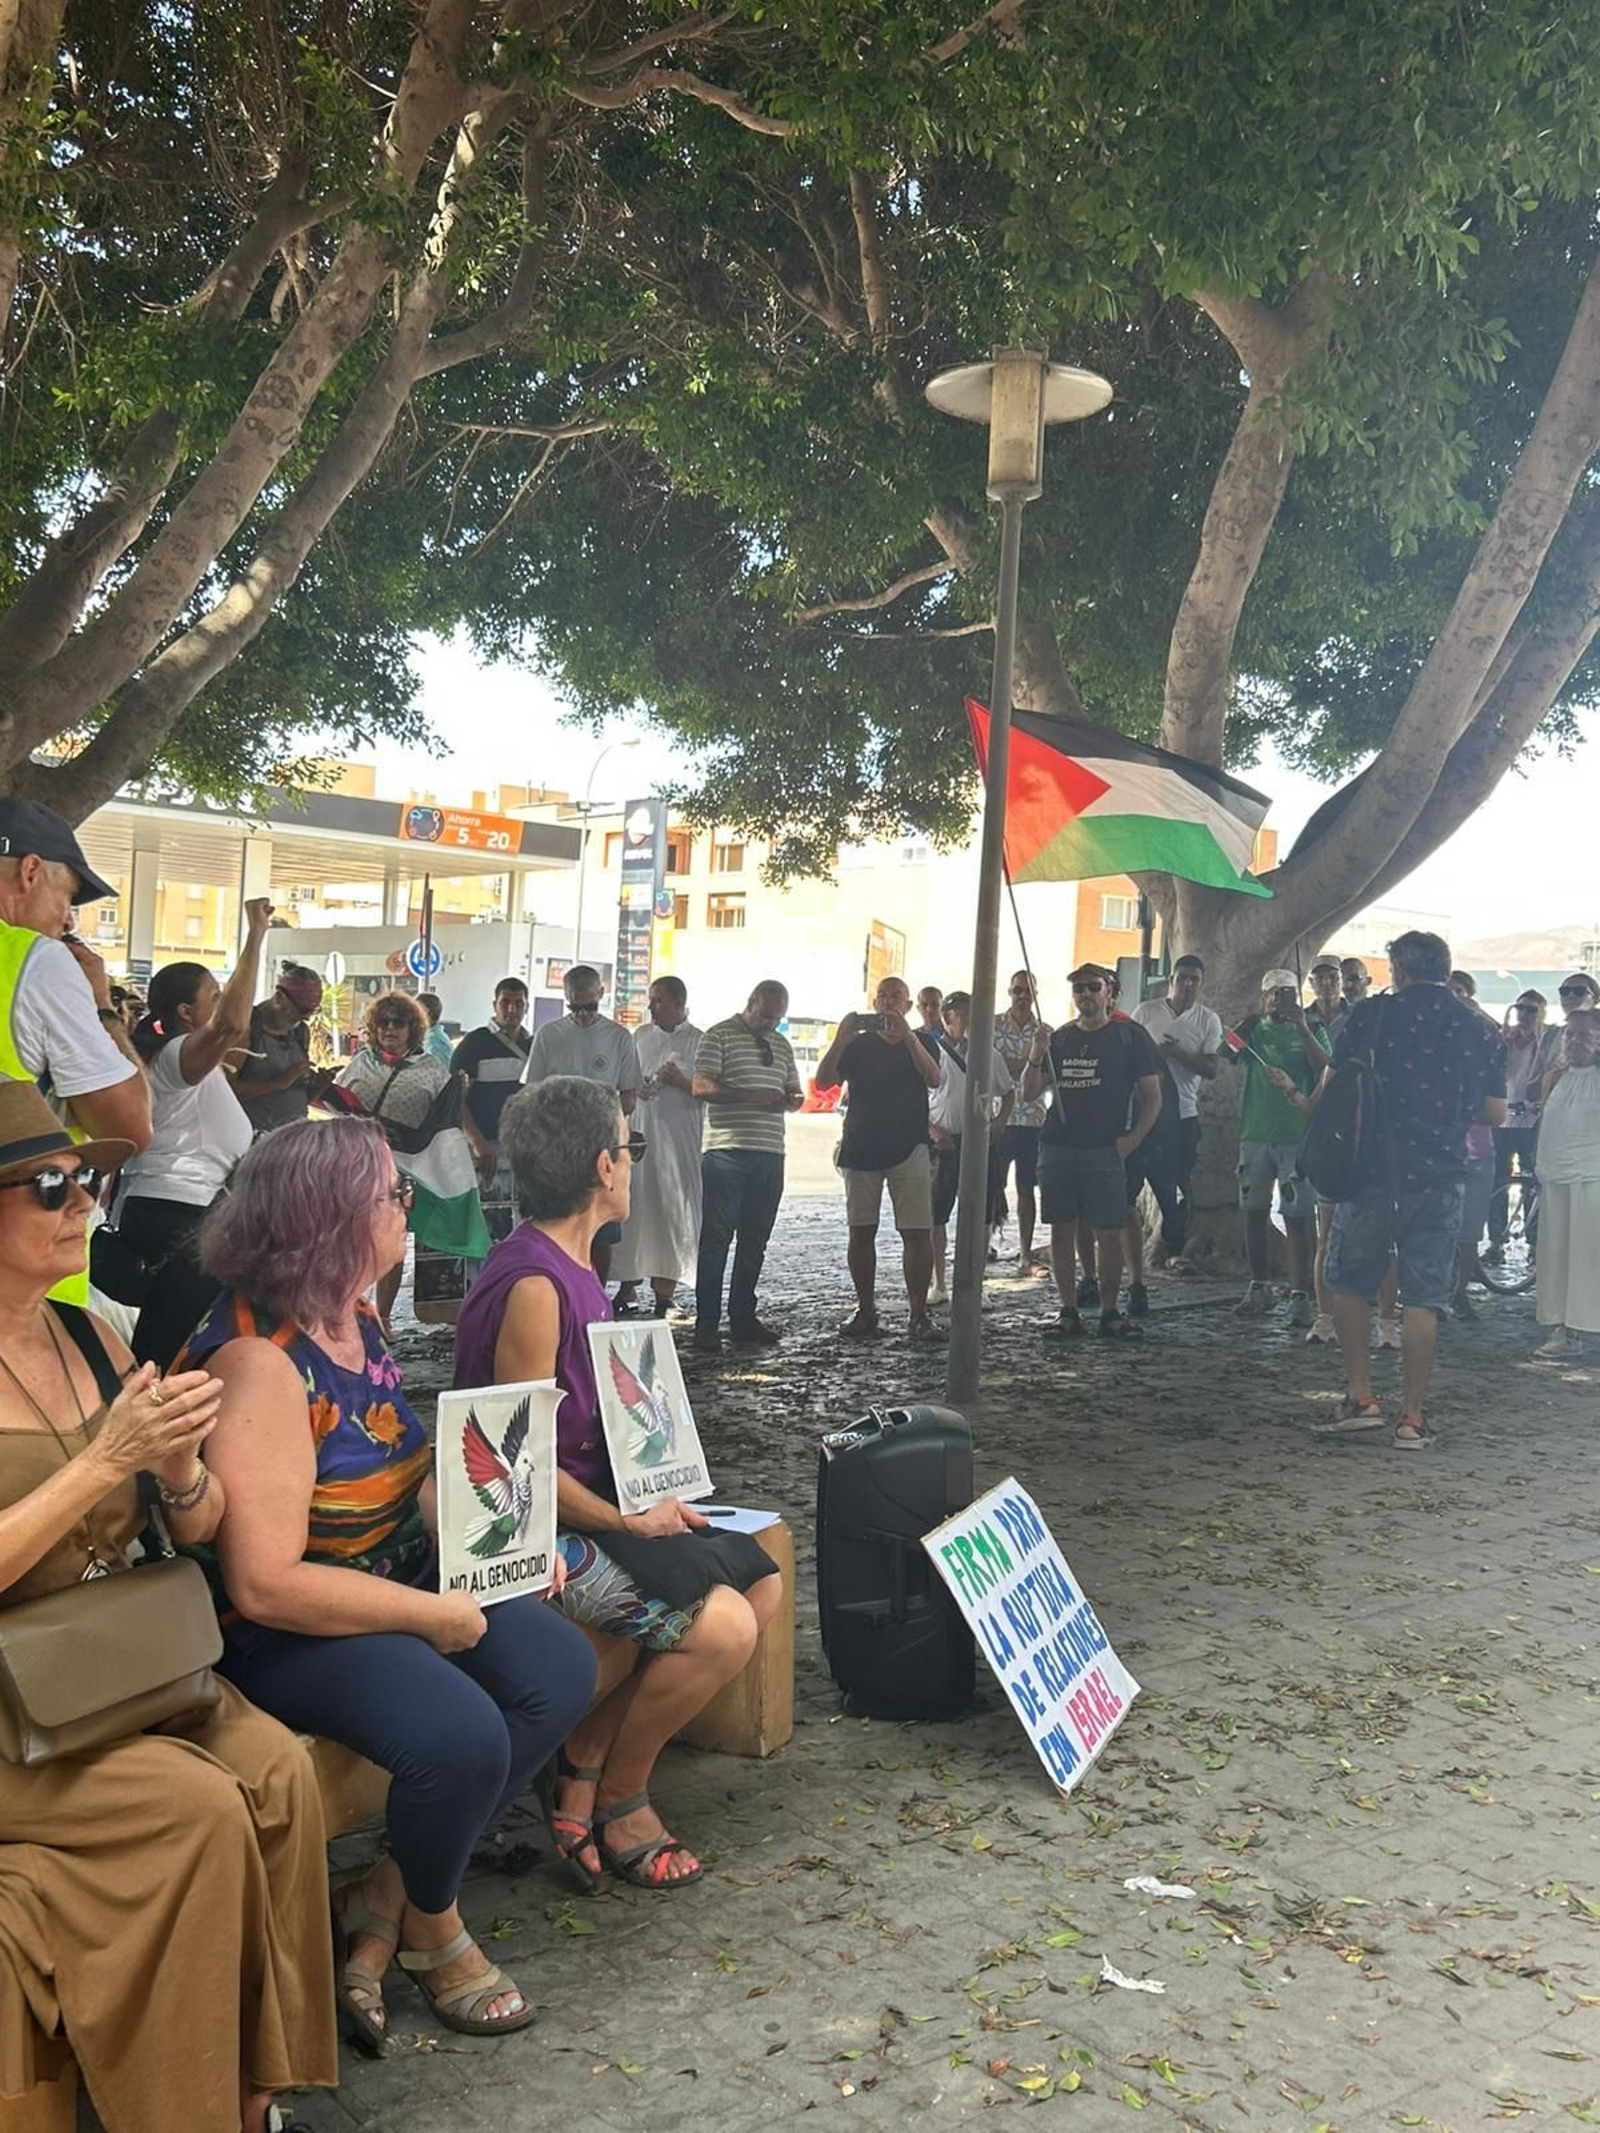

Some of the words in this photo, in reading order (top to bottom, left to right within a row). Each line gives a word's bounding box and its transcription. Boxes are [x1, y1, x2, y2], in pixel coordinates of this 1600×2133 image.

[448, 813, 481, 827] Ahorra
[457, 827, 470, 845] 5
[487, 831, 510, 849] 20
[626, 1478, 641, 1499] NO
[641, 1476, 655, 1497] AL
[653, 1464, 702, 1493] GENOCIDIO
[449, 1572, 468, 1590] NO
[469, 1569, 487, 1594] AL
[488, 1552, 548, 1588] GENOCIDIO
[939, 1519, 1014, 1607] FIRMA
[993, 1494, 1046, 1562] PARA
[978, 1611, 1016, 1671] LA
[1001, 1556, 1076, 1649] RUPTURA
[1011, 1669, 1046, 1727] DE
[1032, 1601, 1107, 1702] RELACIONES
[1039, 1722, 1081, 1784] CON
[1065, 1666, 1123, 1753] ISRAEL
